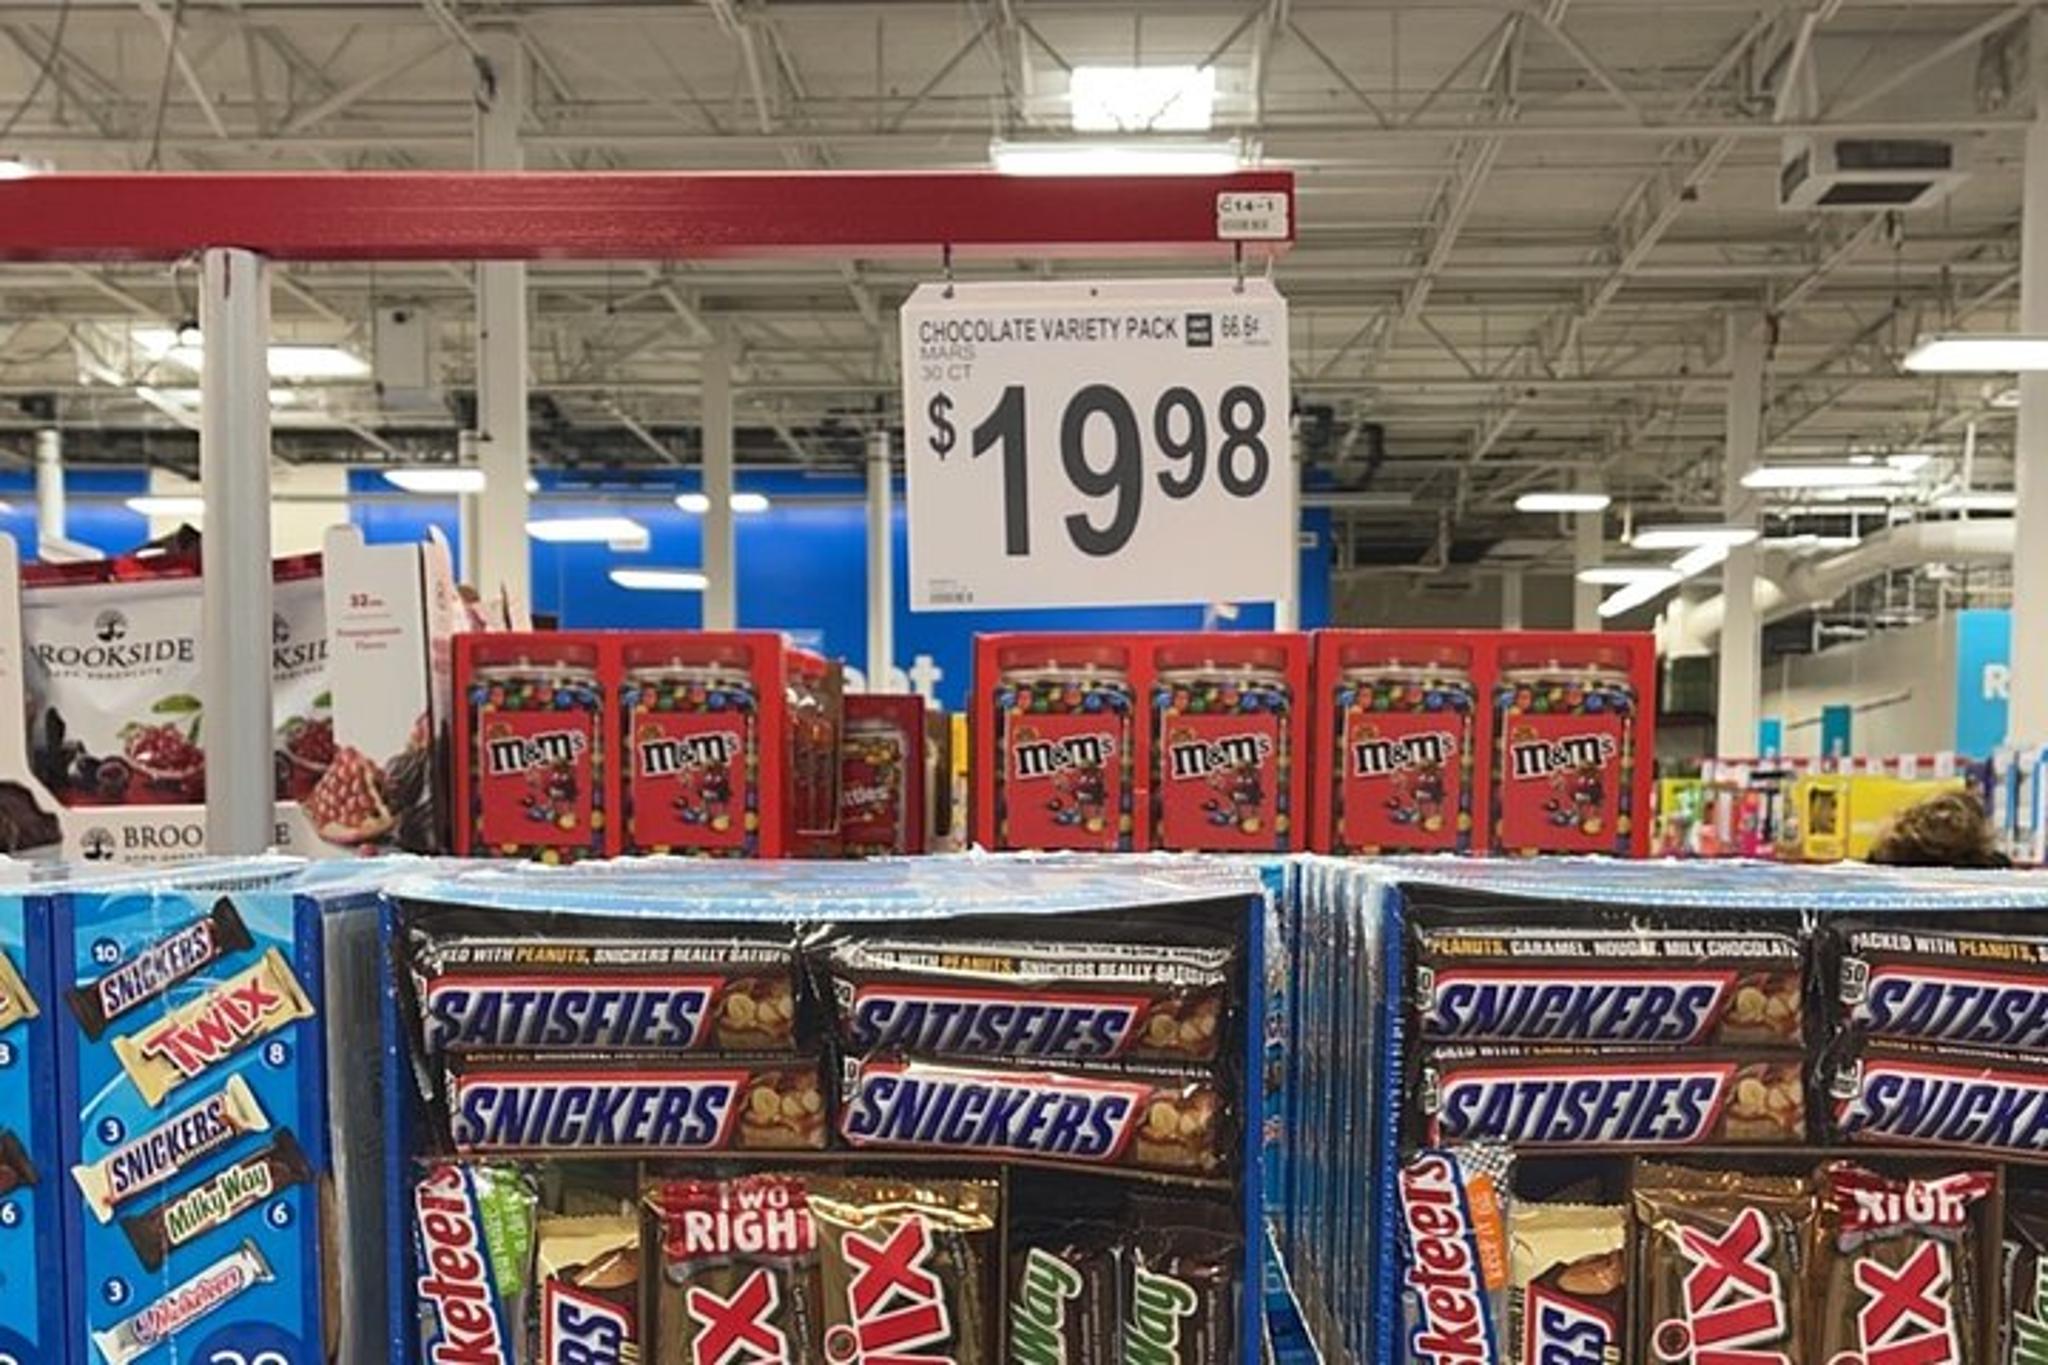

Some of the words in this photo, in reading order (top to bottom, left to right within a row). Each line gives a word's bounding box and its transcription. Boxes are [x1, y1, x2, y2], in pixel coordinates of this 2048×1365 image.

[919, 318, 1036, 344] CHOCOLATE
[1041, 317, 1121, 341] VARIETY
[1126, 316, 1178, 339] PACK
[919, 344, 976, 361] MARS
[946, 363, 973, 380] CT
[30, 636, 195, 669] ROOKSIDE
[94, 944, 119, 962] 10
[1664, 939, 1705, 957] MILK
[1914, 935, 1958, 955] WITH
[473, 948, 514, 963] WITH
[593, 948, 670, 964] SNICKERS
[672, 948, 727, 963] REALLY
[104, 925, 209, 1013] SNICKERS
[1020, 959, 1096, 978] SNICKERS
[1099, 962, 1152, 977] REALLY
[430, 990, 705, 1049] SATISFIES
[1424, 983, 1717, 1044] SNICKERS
[855, 999, 1129, 1058] SATISFIES
[269, 1044, 285, 1064] 8
[457, 1085, 735, 1147] SNICKERS
[849, 1077, 1132, 1155] SNICKERS
[1440, 1077, 1715, 1141] SATISFIES
[105, 1121, 120, 1142] 3
[112, 1100, 227, 1193] SNICKERS
[2, 1203, 15, 1223] 6
[272, 1203, 288, 1224] 6
[109, 1280, 123, 1301] 3
